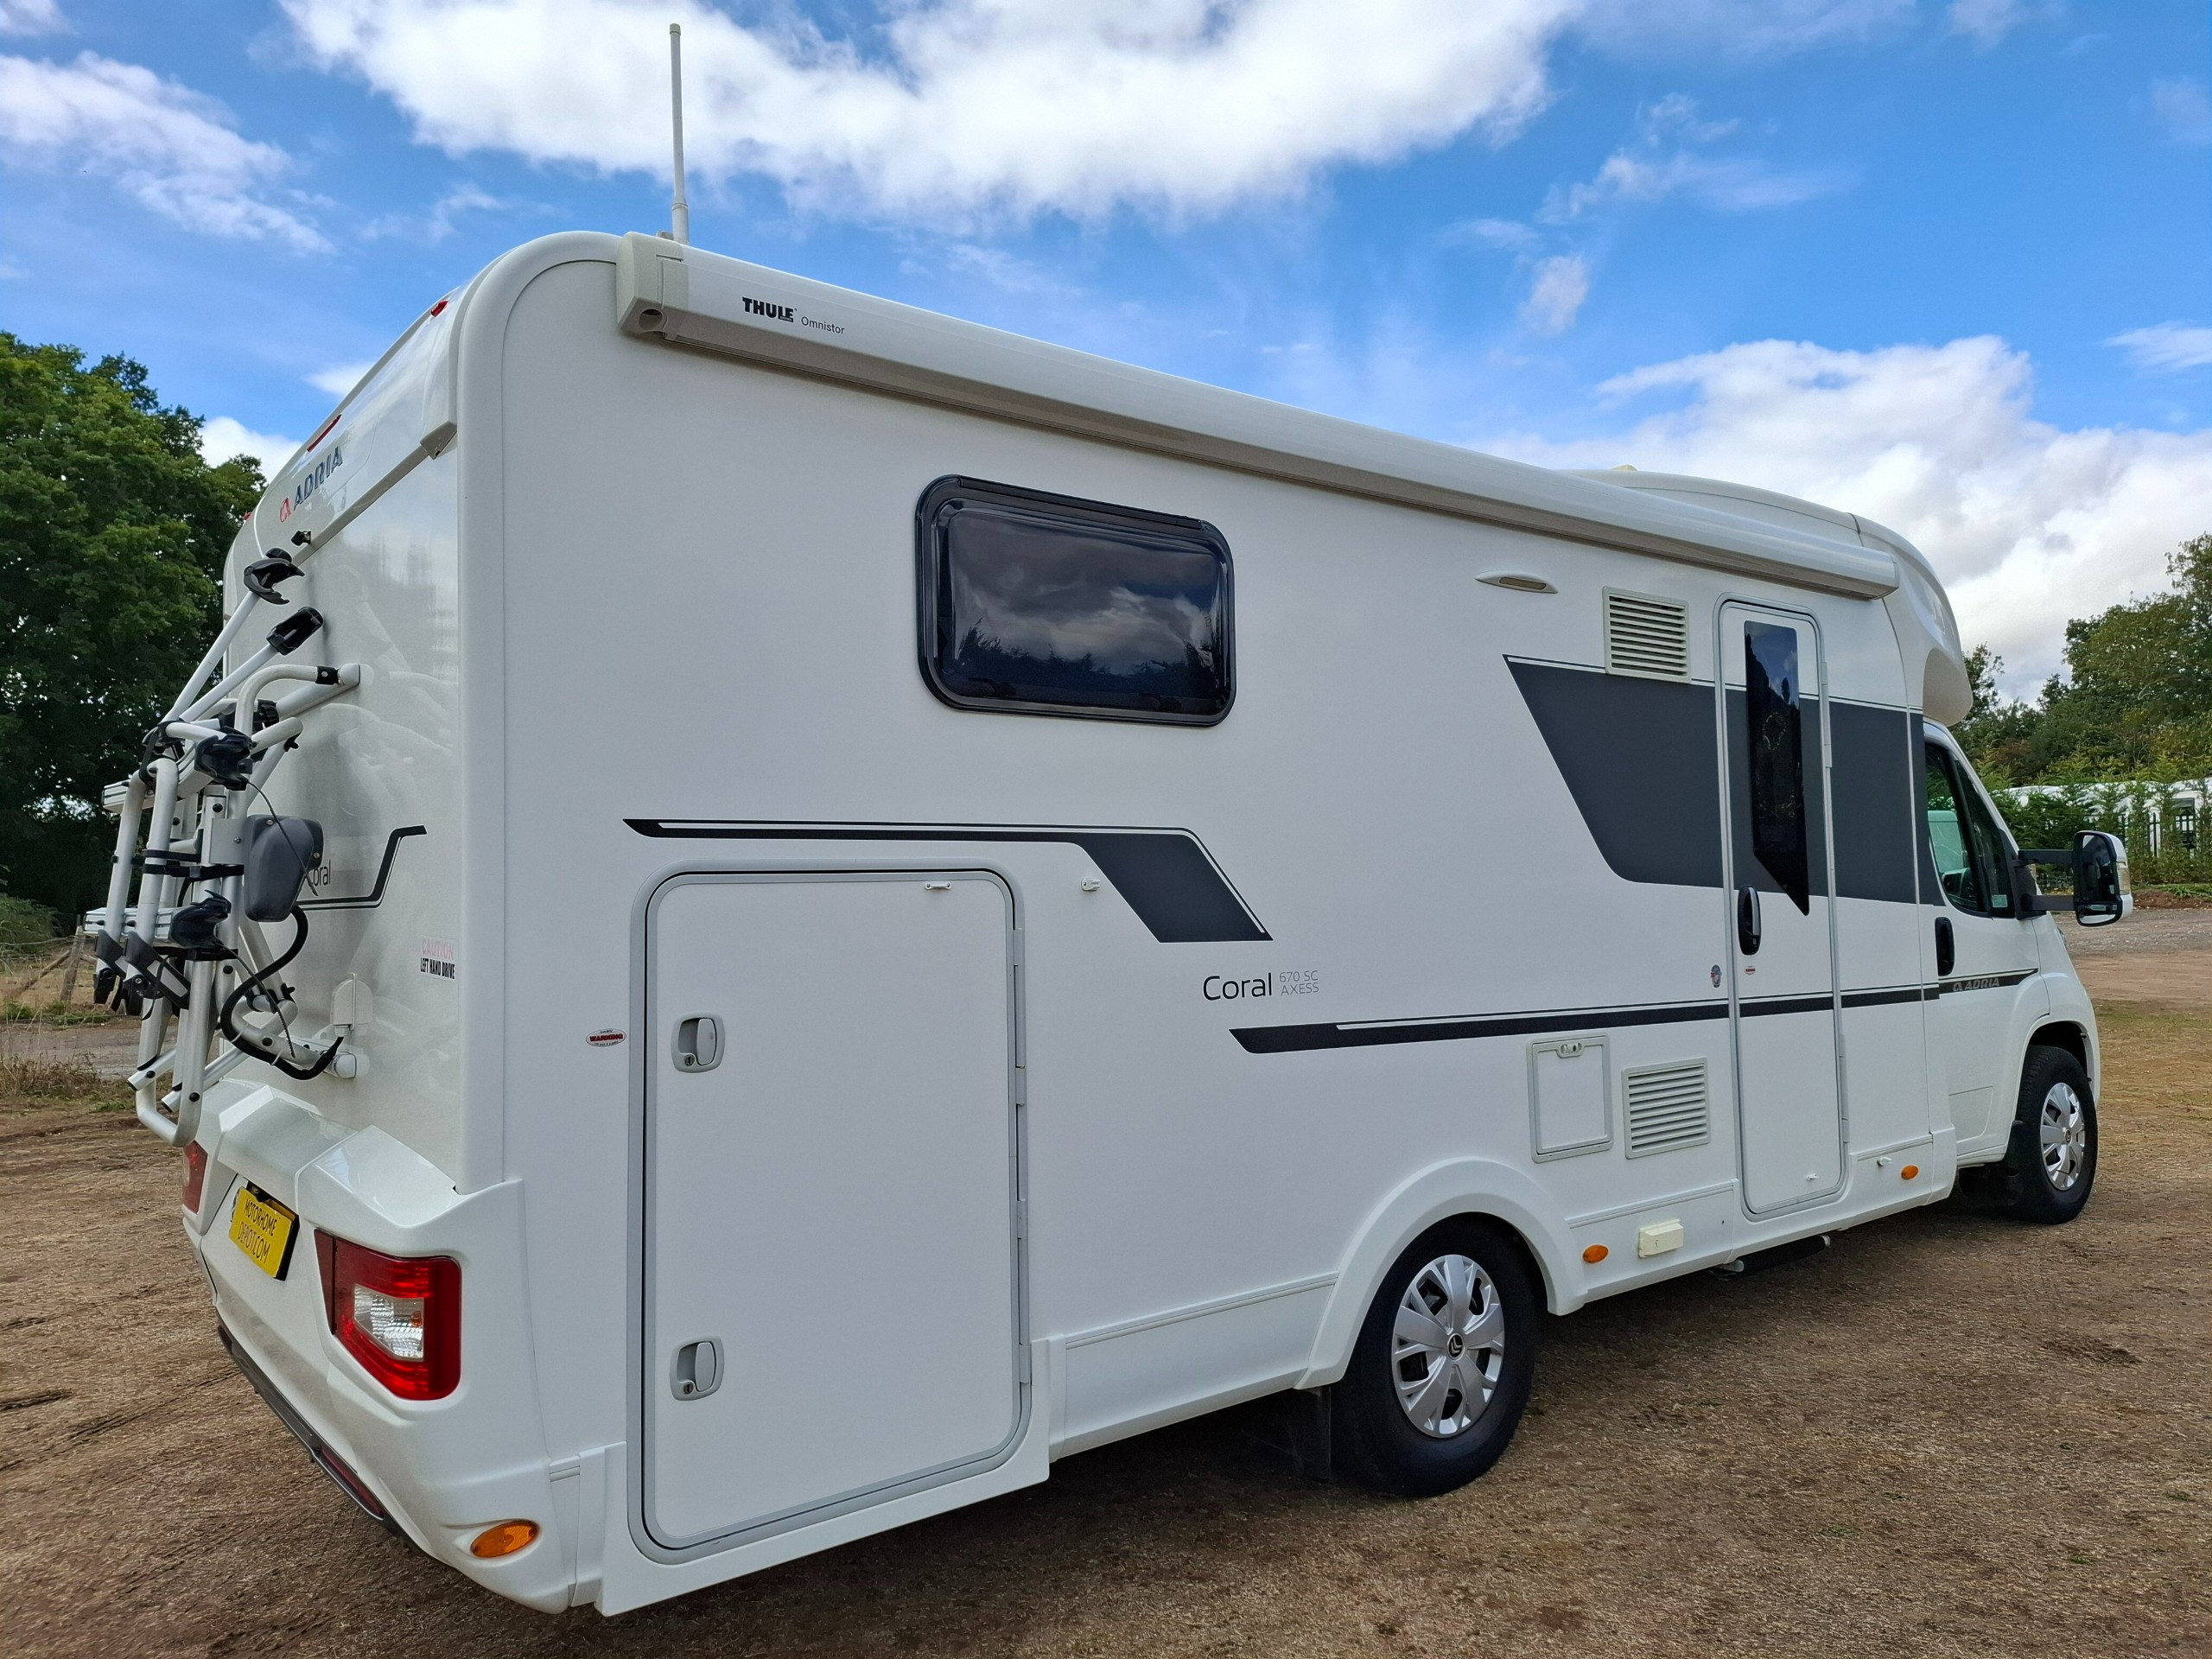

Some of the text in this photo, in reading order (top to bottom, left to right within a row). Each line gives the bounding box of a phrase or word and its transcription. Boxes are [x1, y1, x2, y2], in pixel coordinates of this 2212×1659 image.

[742, 296, 845, 334] THULE Omnistor
[294, 446, 343, 511] ADRIA
[422, 938, 454, 960] CAUTION
[1203, 969, 1319, 1001] Coral 670 SC
[1281, 982, 1319, 995] AXESS
[243, 1198, 277, 1236] MOTORHOME
